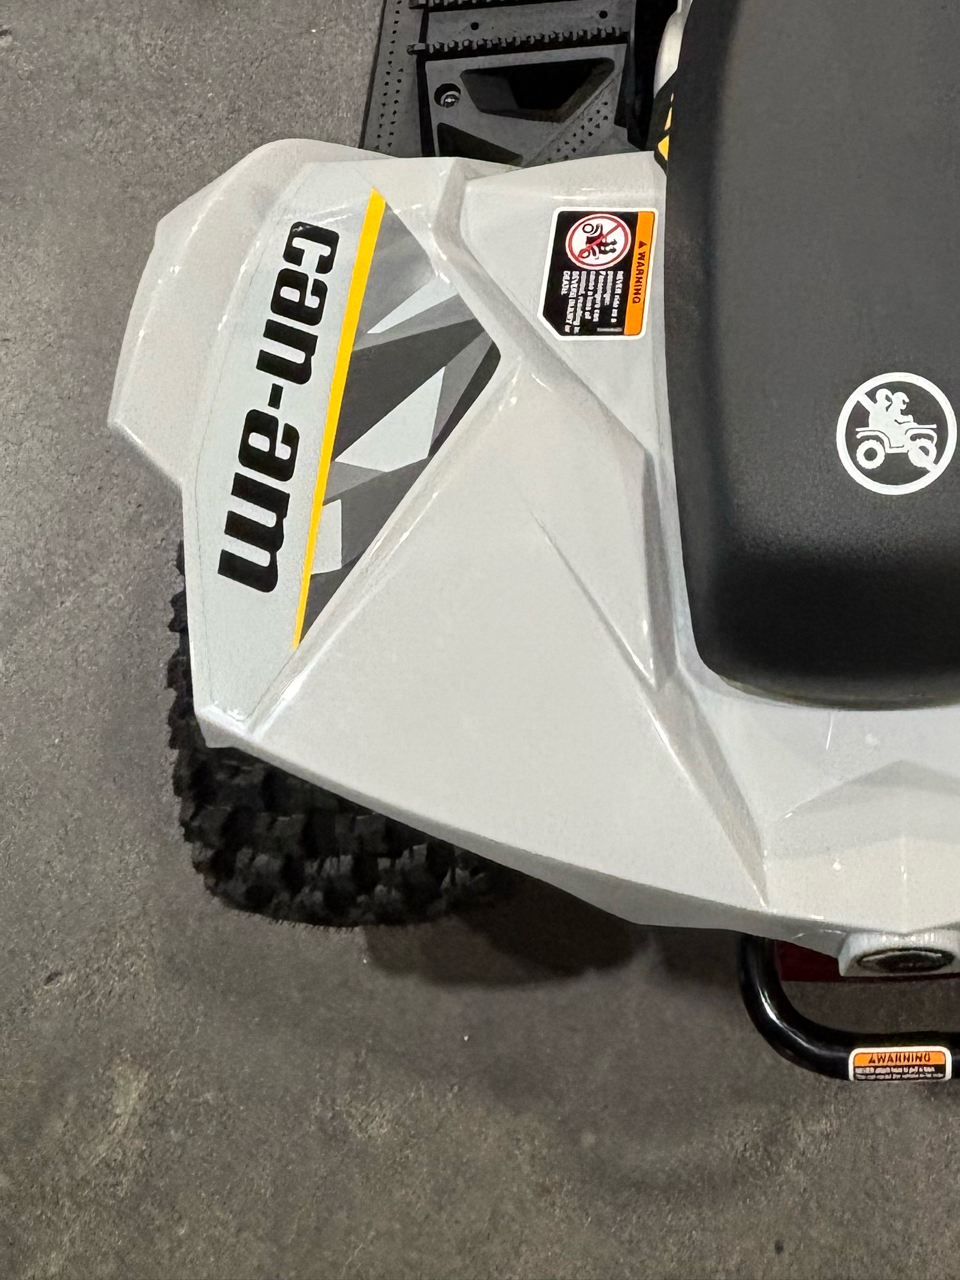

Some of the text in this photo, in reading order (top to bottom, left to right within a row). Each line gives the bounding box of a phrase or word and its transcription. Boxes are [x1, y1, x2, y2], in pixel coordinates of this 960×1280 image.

[632, 251, 646, 304] WARNING
[218, 222, 339, 593] can-am
[877, 1052, 931, 1064] WARNING
